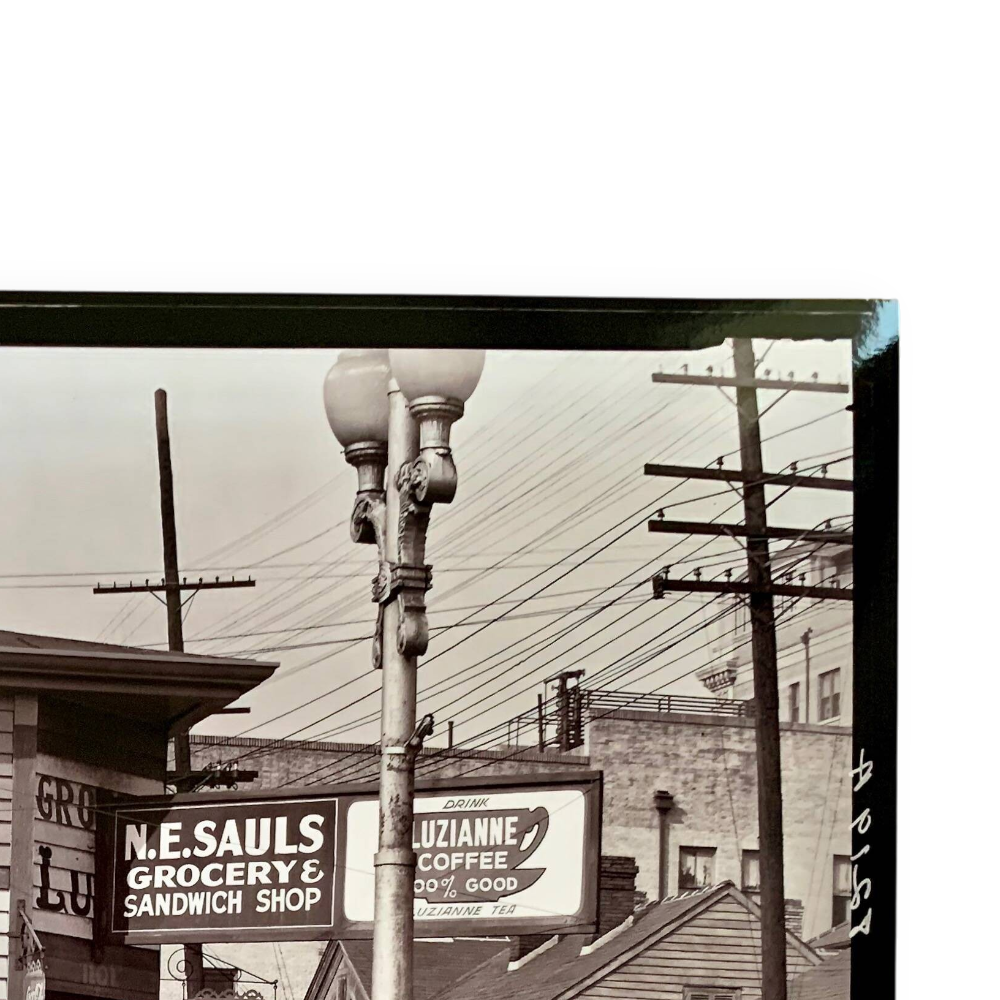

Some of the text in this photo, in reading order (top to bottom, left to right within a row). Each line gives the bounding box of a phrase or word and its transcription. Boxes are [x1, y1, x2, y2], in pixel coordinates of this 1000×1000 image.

[443, 797, 490, 810] DRINK
[418, 851, 509, 872] COFFEE
[127, 860, 299, 890] GROCERY
[413, 875, 518, 899] 00% GOOD
[123, 887, 322, 918] SANDWICH SHOP
[415, 904, 517, 917] UZIANNE TEA
